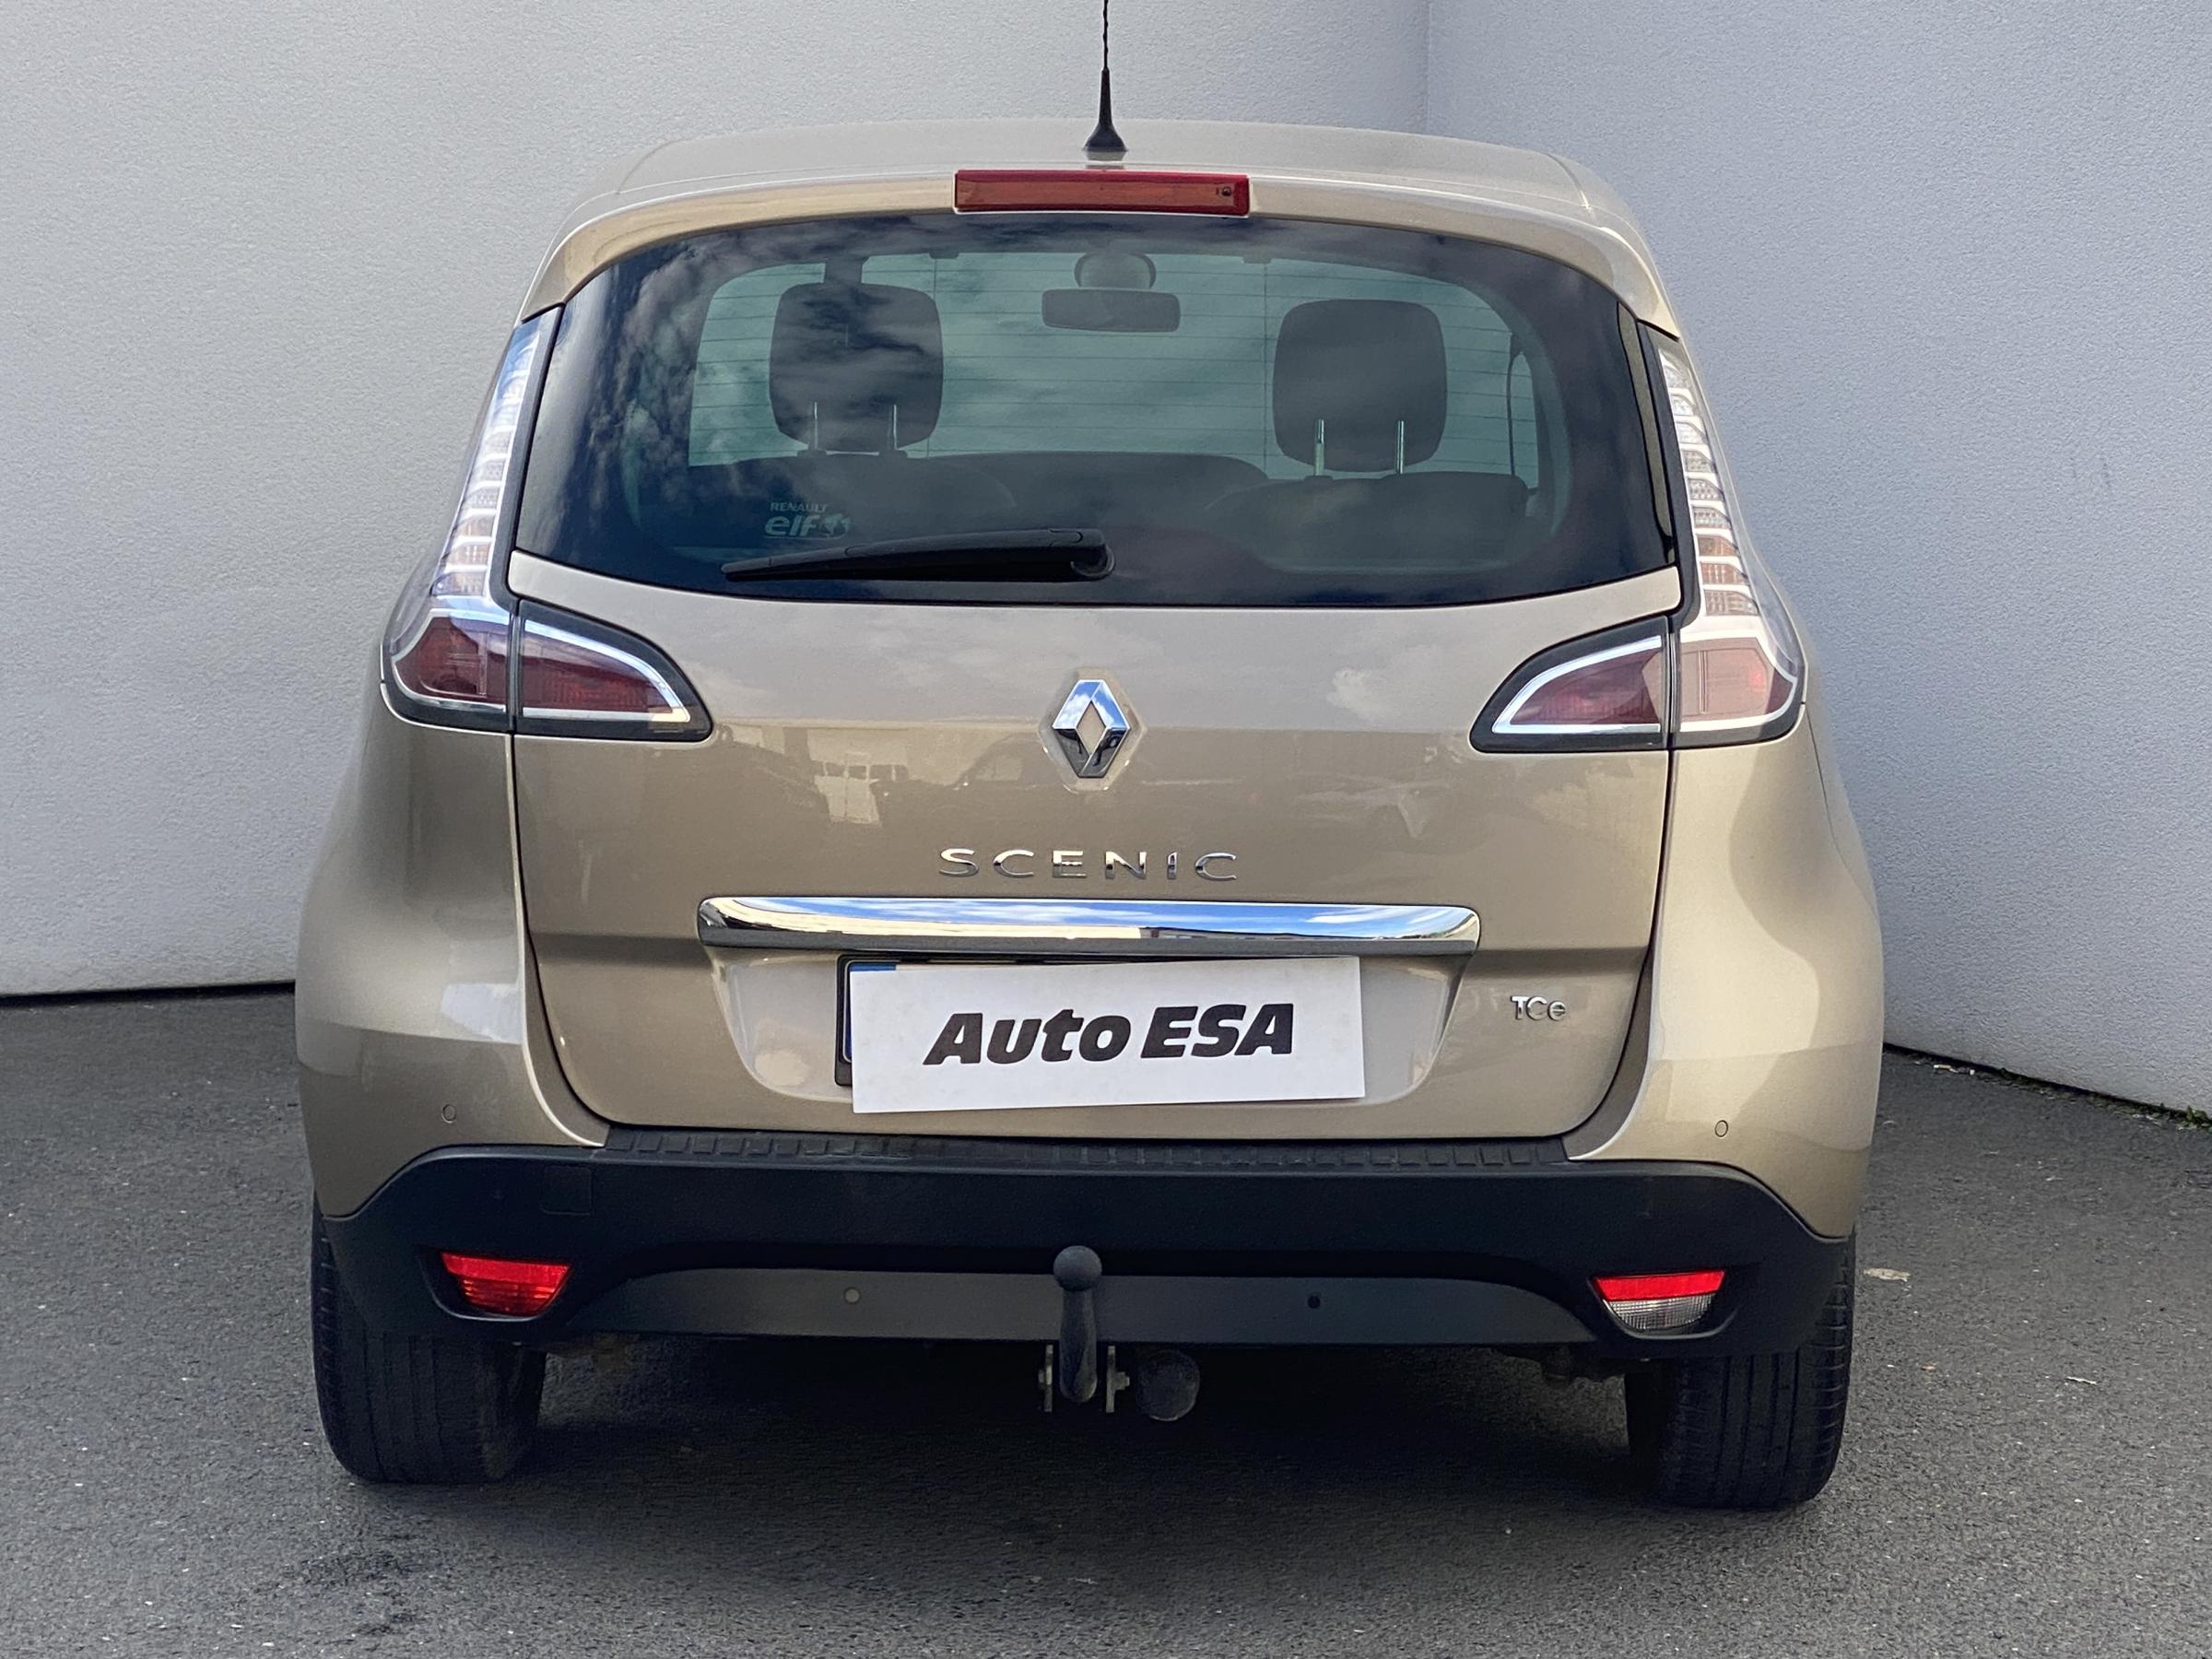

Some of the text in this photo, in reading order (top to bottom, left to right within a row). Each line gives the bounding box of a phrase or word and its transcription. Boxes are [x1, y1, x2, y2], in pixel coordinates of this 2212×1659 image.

[770, 501, 828, 513] RENAULT
[764, 514, 820, 536] elf
[938, 848, 1237, 880] SCENIC
[1511, 995, 1566, 1021] TCe
[923, 1003, 1293, 1065] Auto ESA
